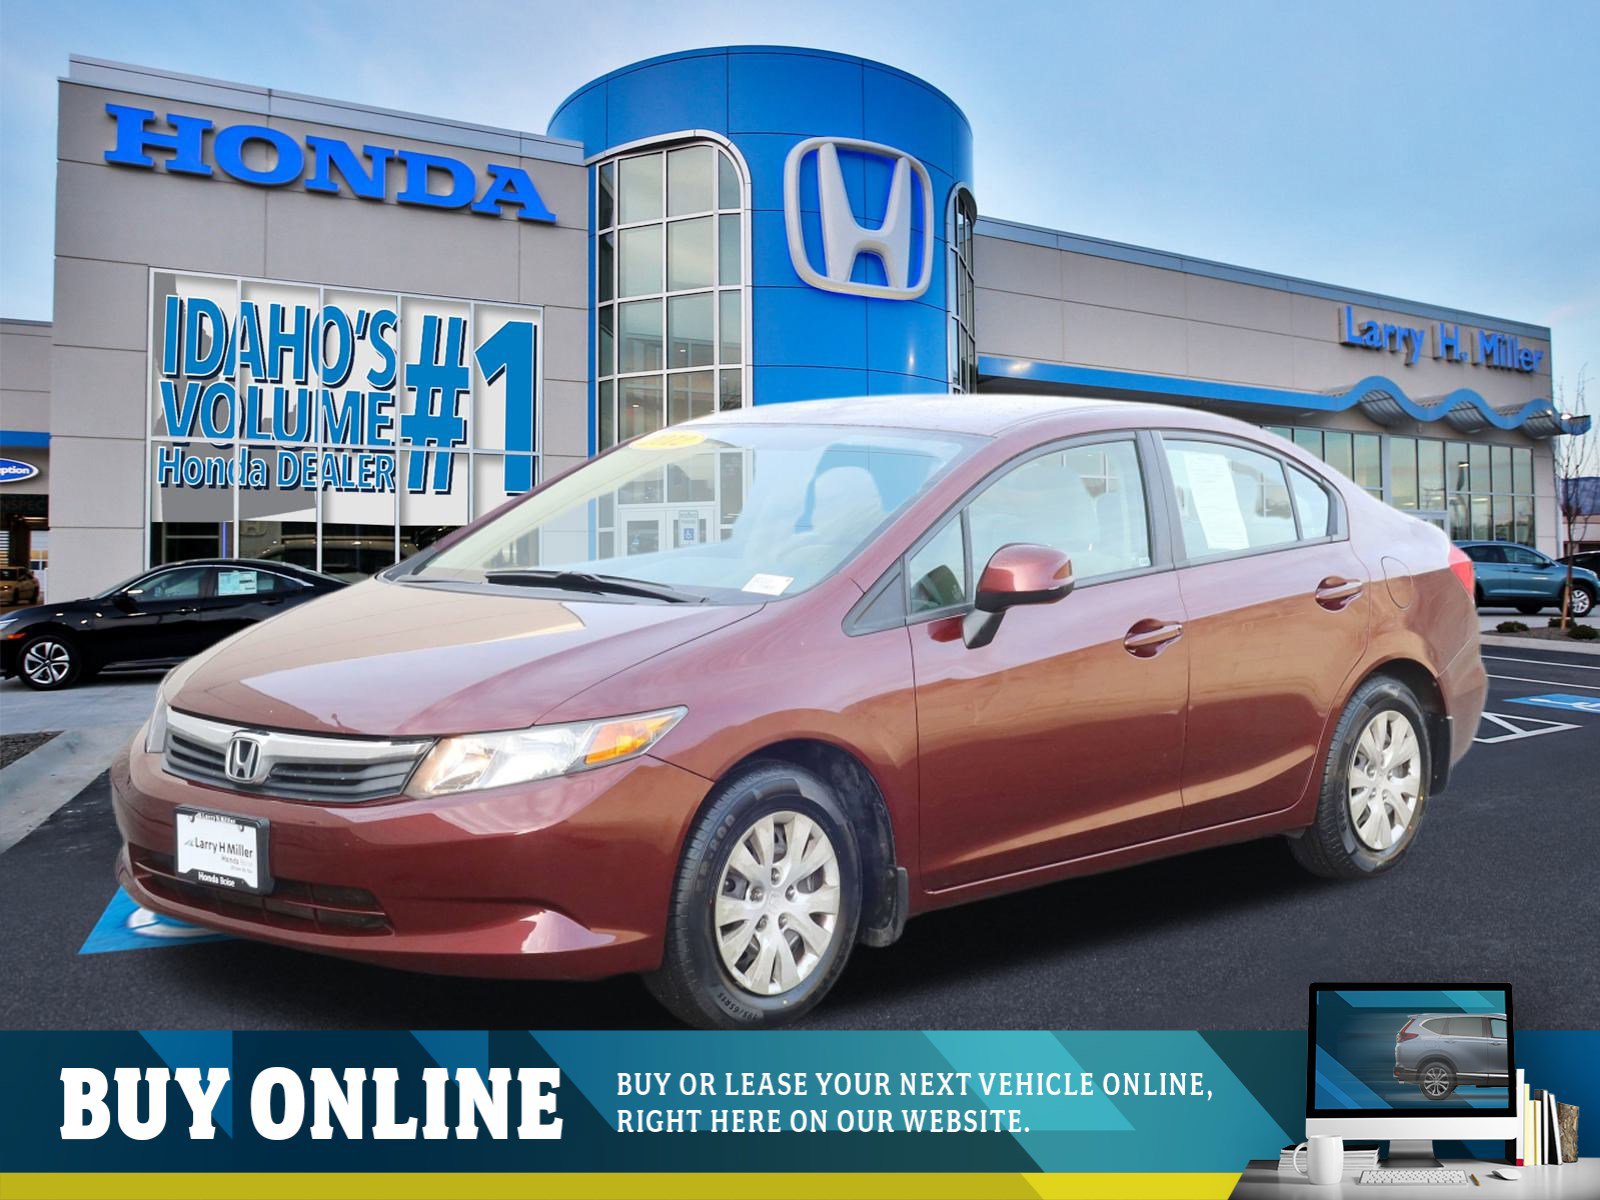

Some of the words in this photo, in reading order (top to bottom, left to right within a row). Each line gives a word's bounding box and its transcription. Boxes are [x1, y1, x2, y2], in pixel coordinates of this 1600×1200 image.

[104, 103, 558, 224] HONDA
[162, 295, 398, 391] IDAHO'S
[1340, 305, 1425, 366] Larry
[1436, 323, 1468, 362] H.
[1474, 330, 1545, 373] Miller
[160, 380, 397, 449] VOLUME
[400, 315, 537, 497] #1
[157, 447, 268, 490] Honda
[276, 451, 397, 493] DEALER
[195, 837, 218, 854] Larry
[219, 841, 226, 853] H
[226, 844, 254, 859] Miller
[198, 871, 219, 884] Honda
